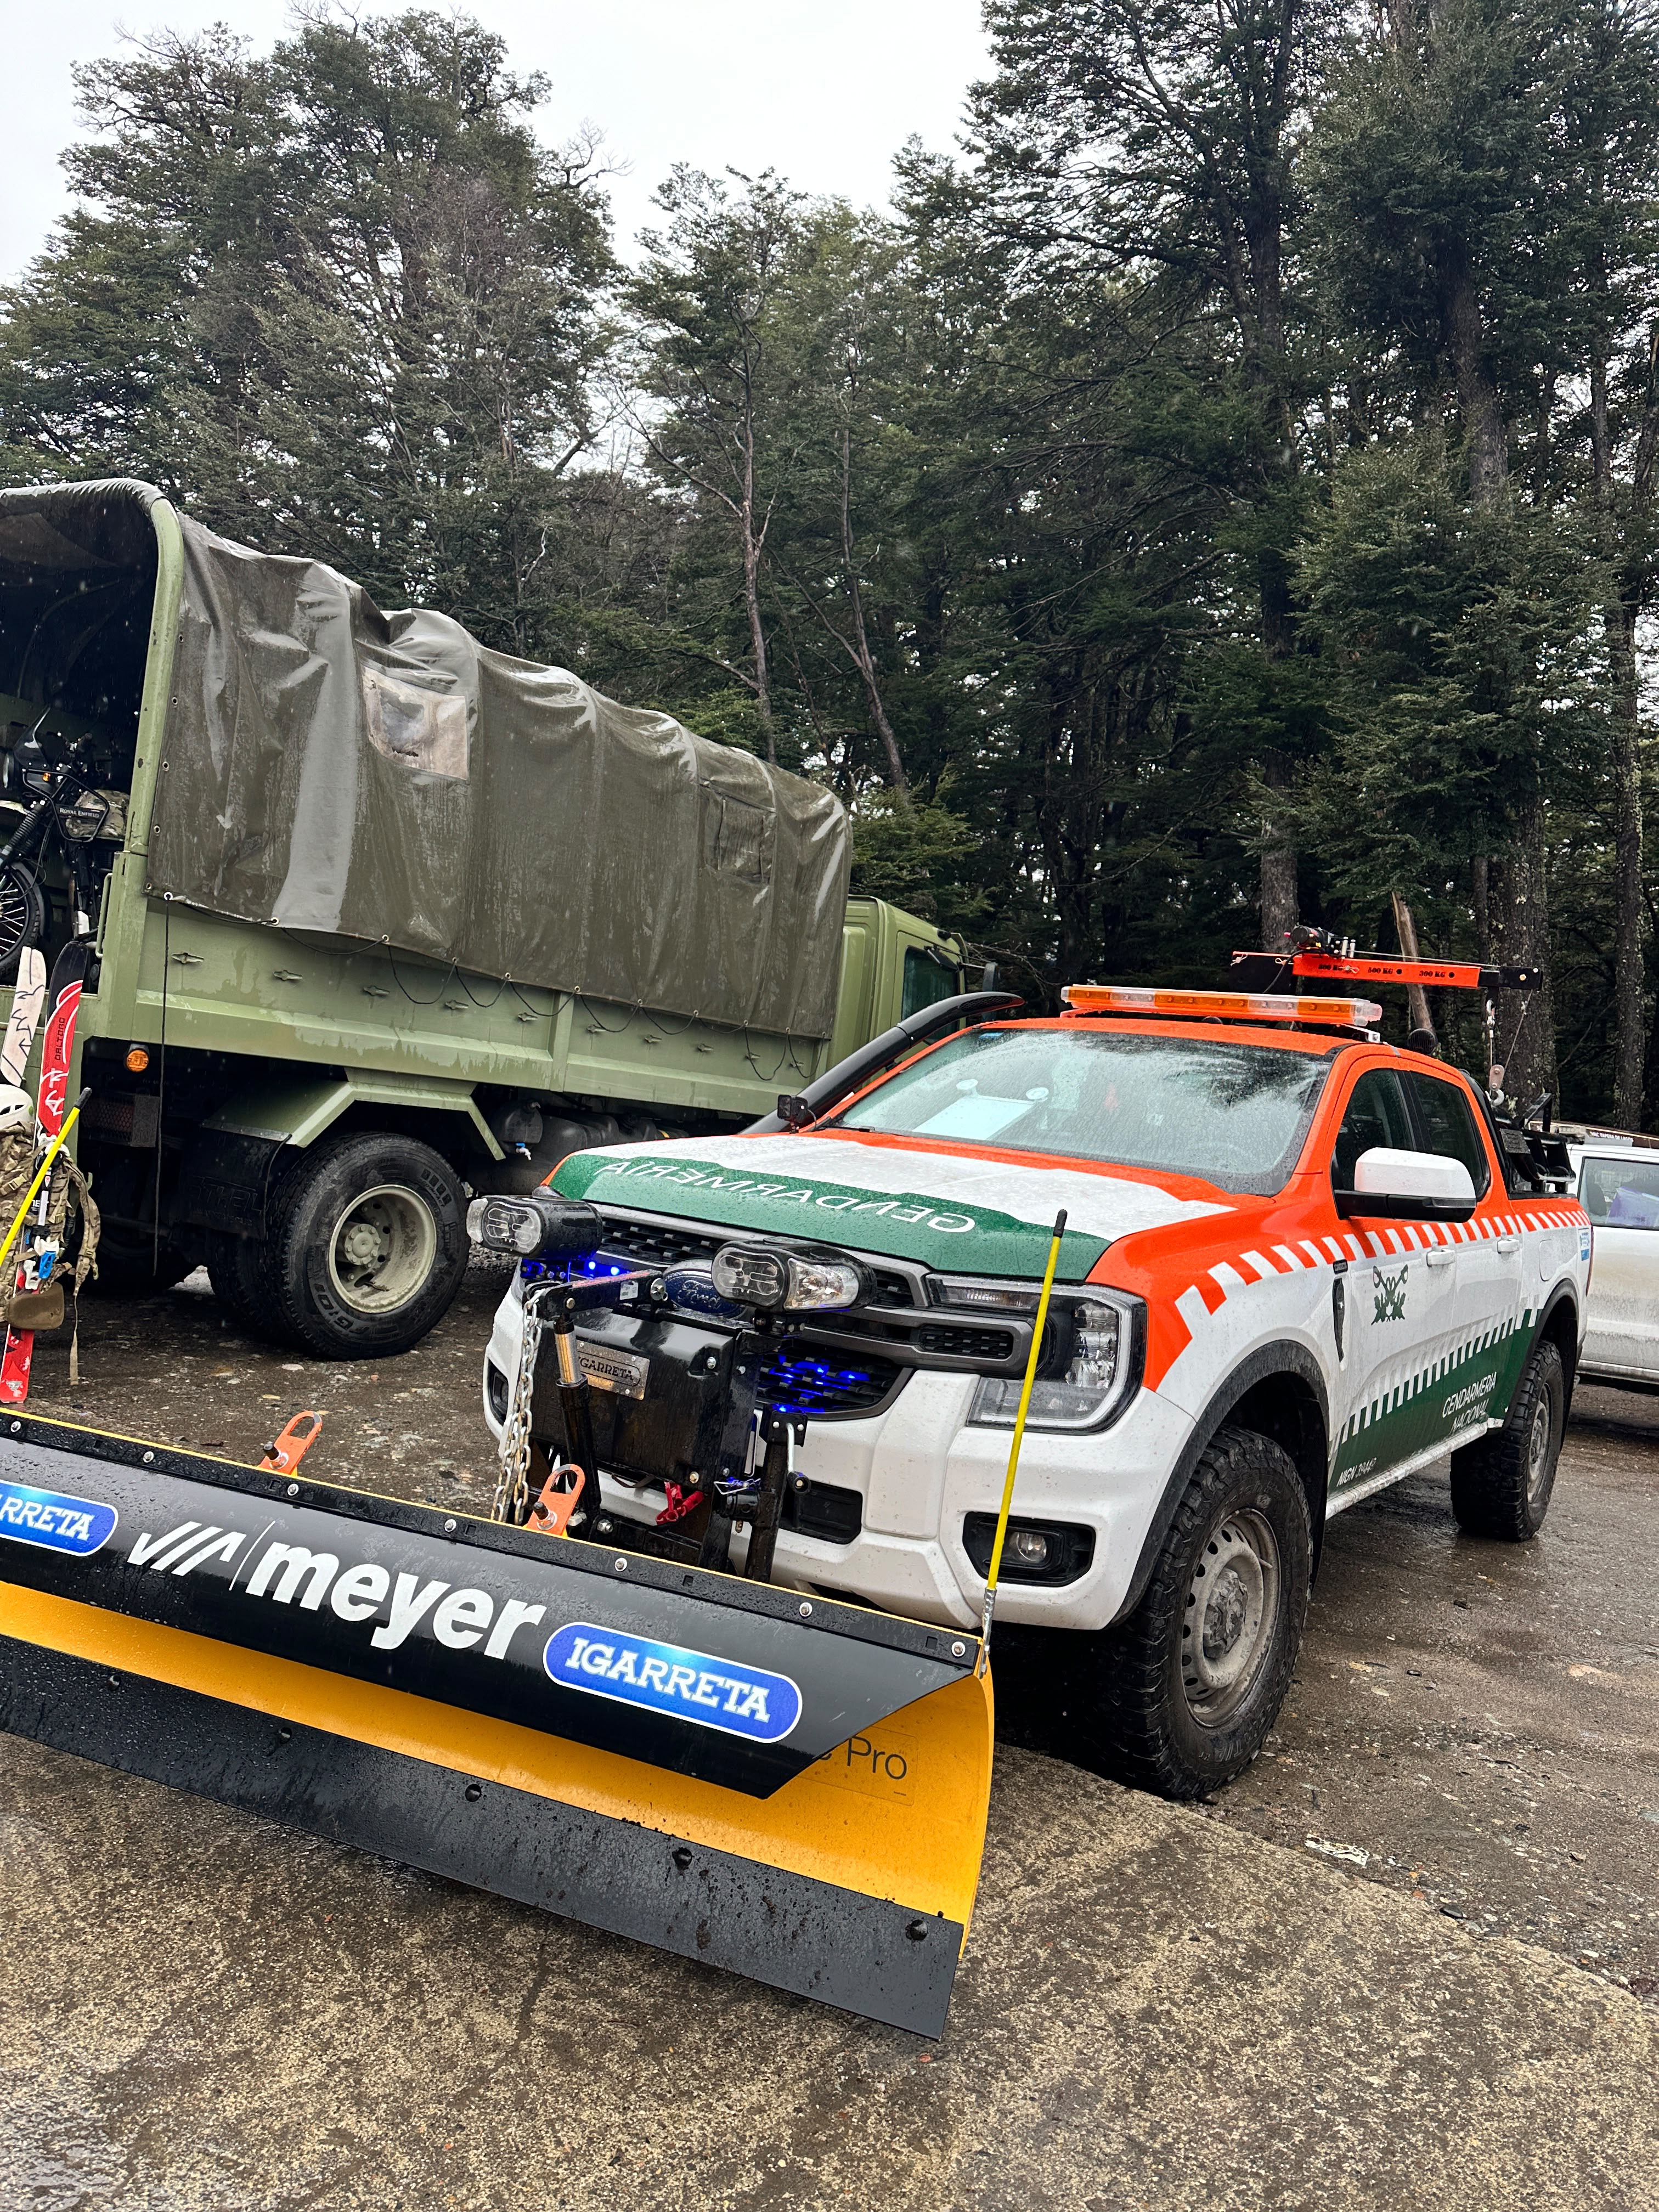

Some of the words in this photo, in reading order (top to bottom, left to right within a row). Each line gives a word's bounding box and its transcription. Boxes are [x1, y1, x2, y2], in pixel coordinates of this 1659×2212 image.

[579, 1356, 634, 1381] GARRETA
[1442, 1372, 1497, 1418] GENDARMERIA
[0, 1494, 95, 1541] RRETA
[245, 1542, 547, 1660] meyer
[565, 1637, 771, 1723] IGARRETA
[847, 1735, 907, 1780] Pro
